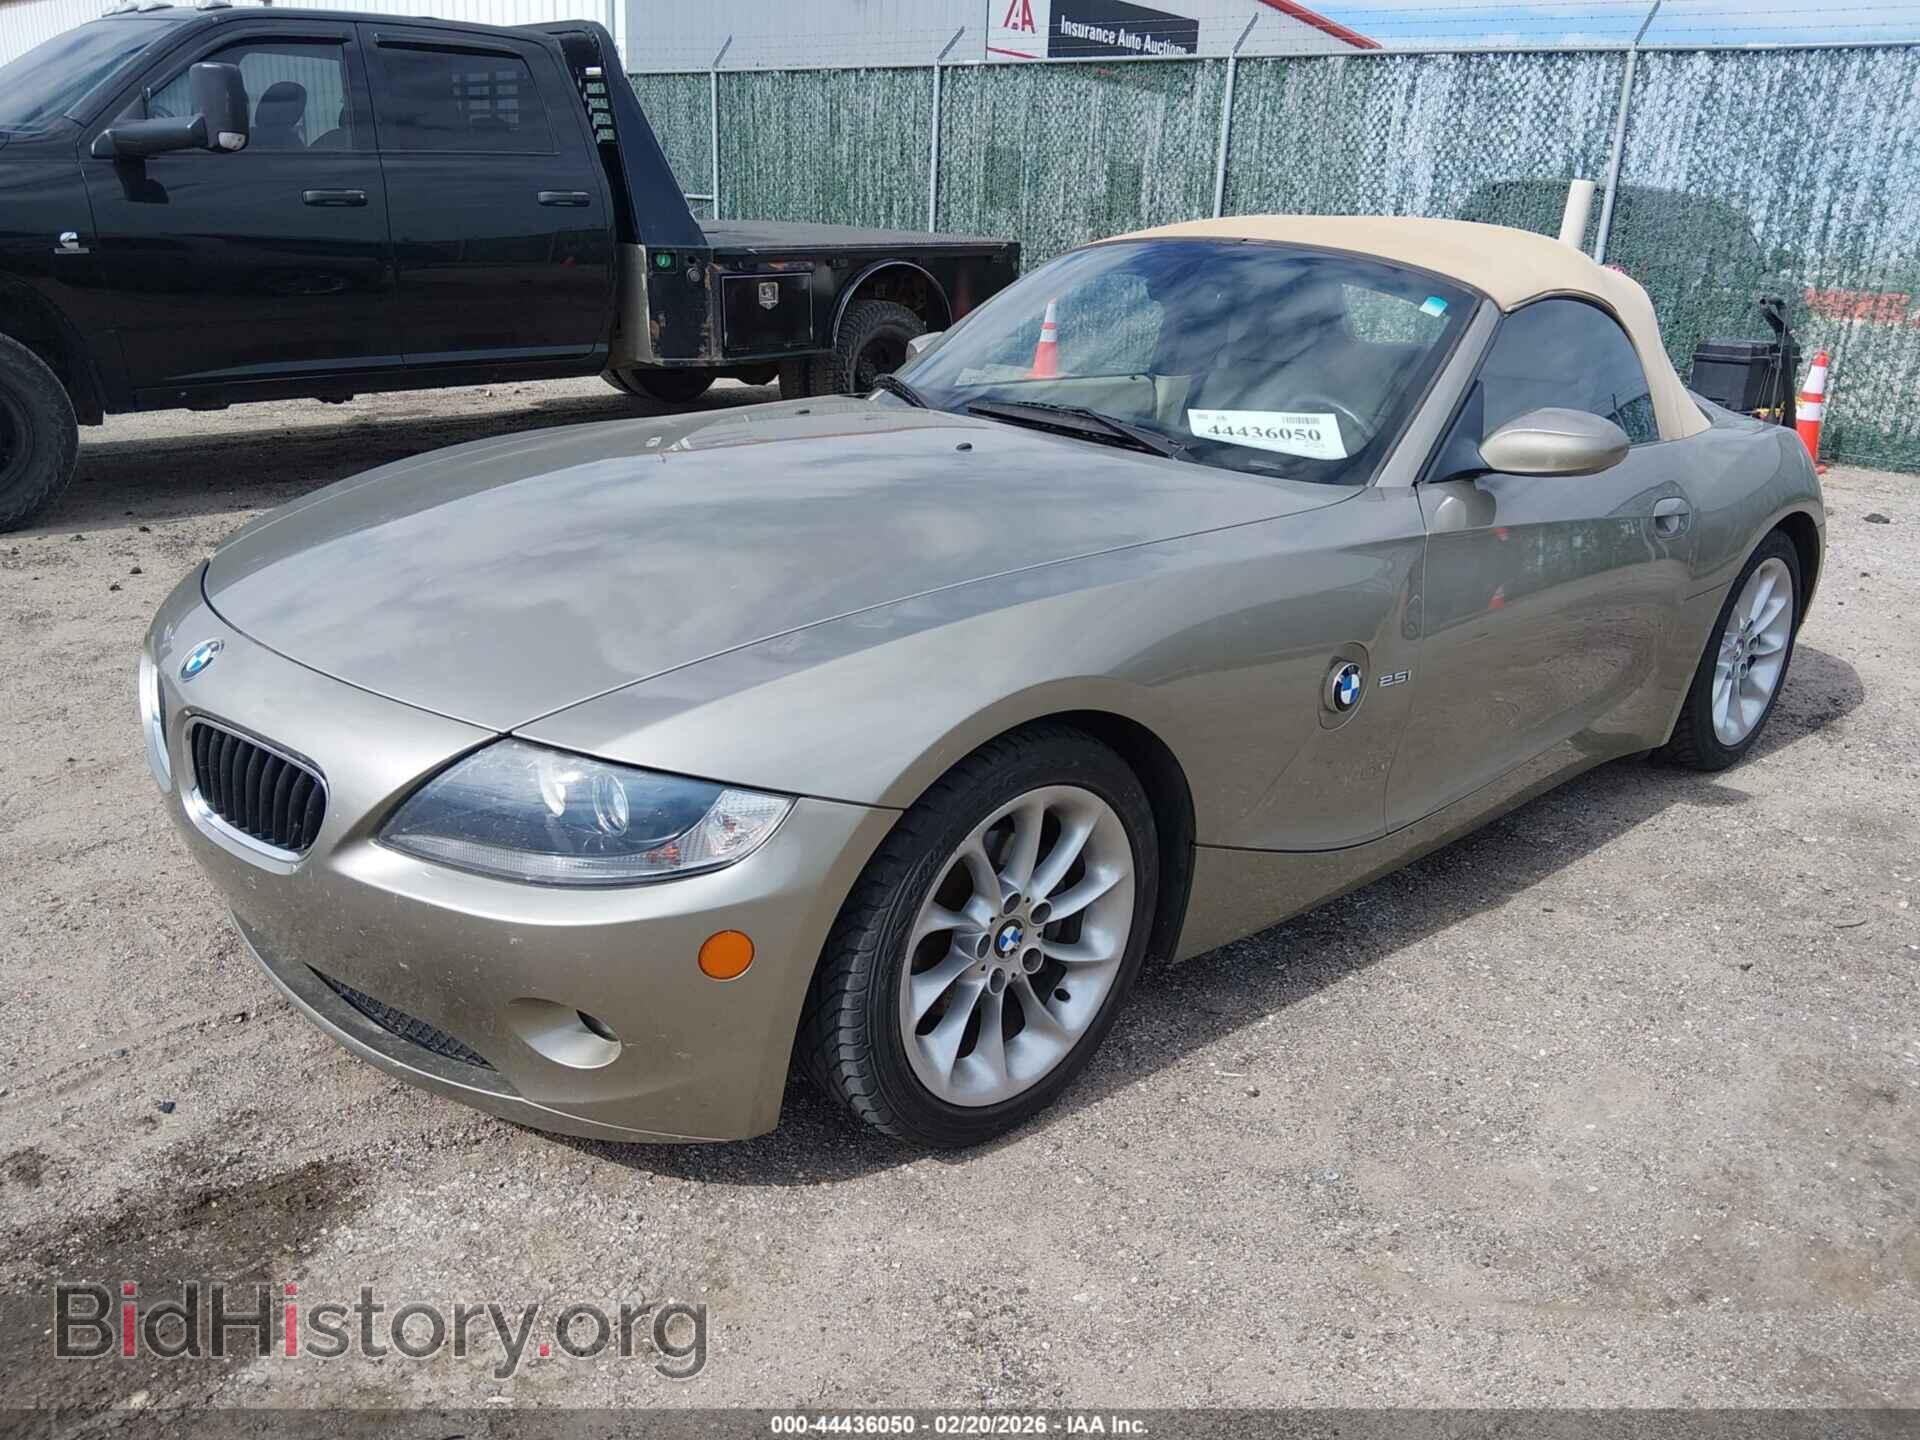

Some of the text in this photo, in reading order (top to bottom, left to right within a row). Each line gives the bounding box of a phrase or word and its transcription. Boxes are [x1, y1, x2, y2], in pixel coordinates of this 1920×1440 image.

[1061, 15, 1187, 56] Insurance Auto Auctions
[1207, 424, 1321, 441] 44436050
